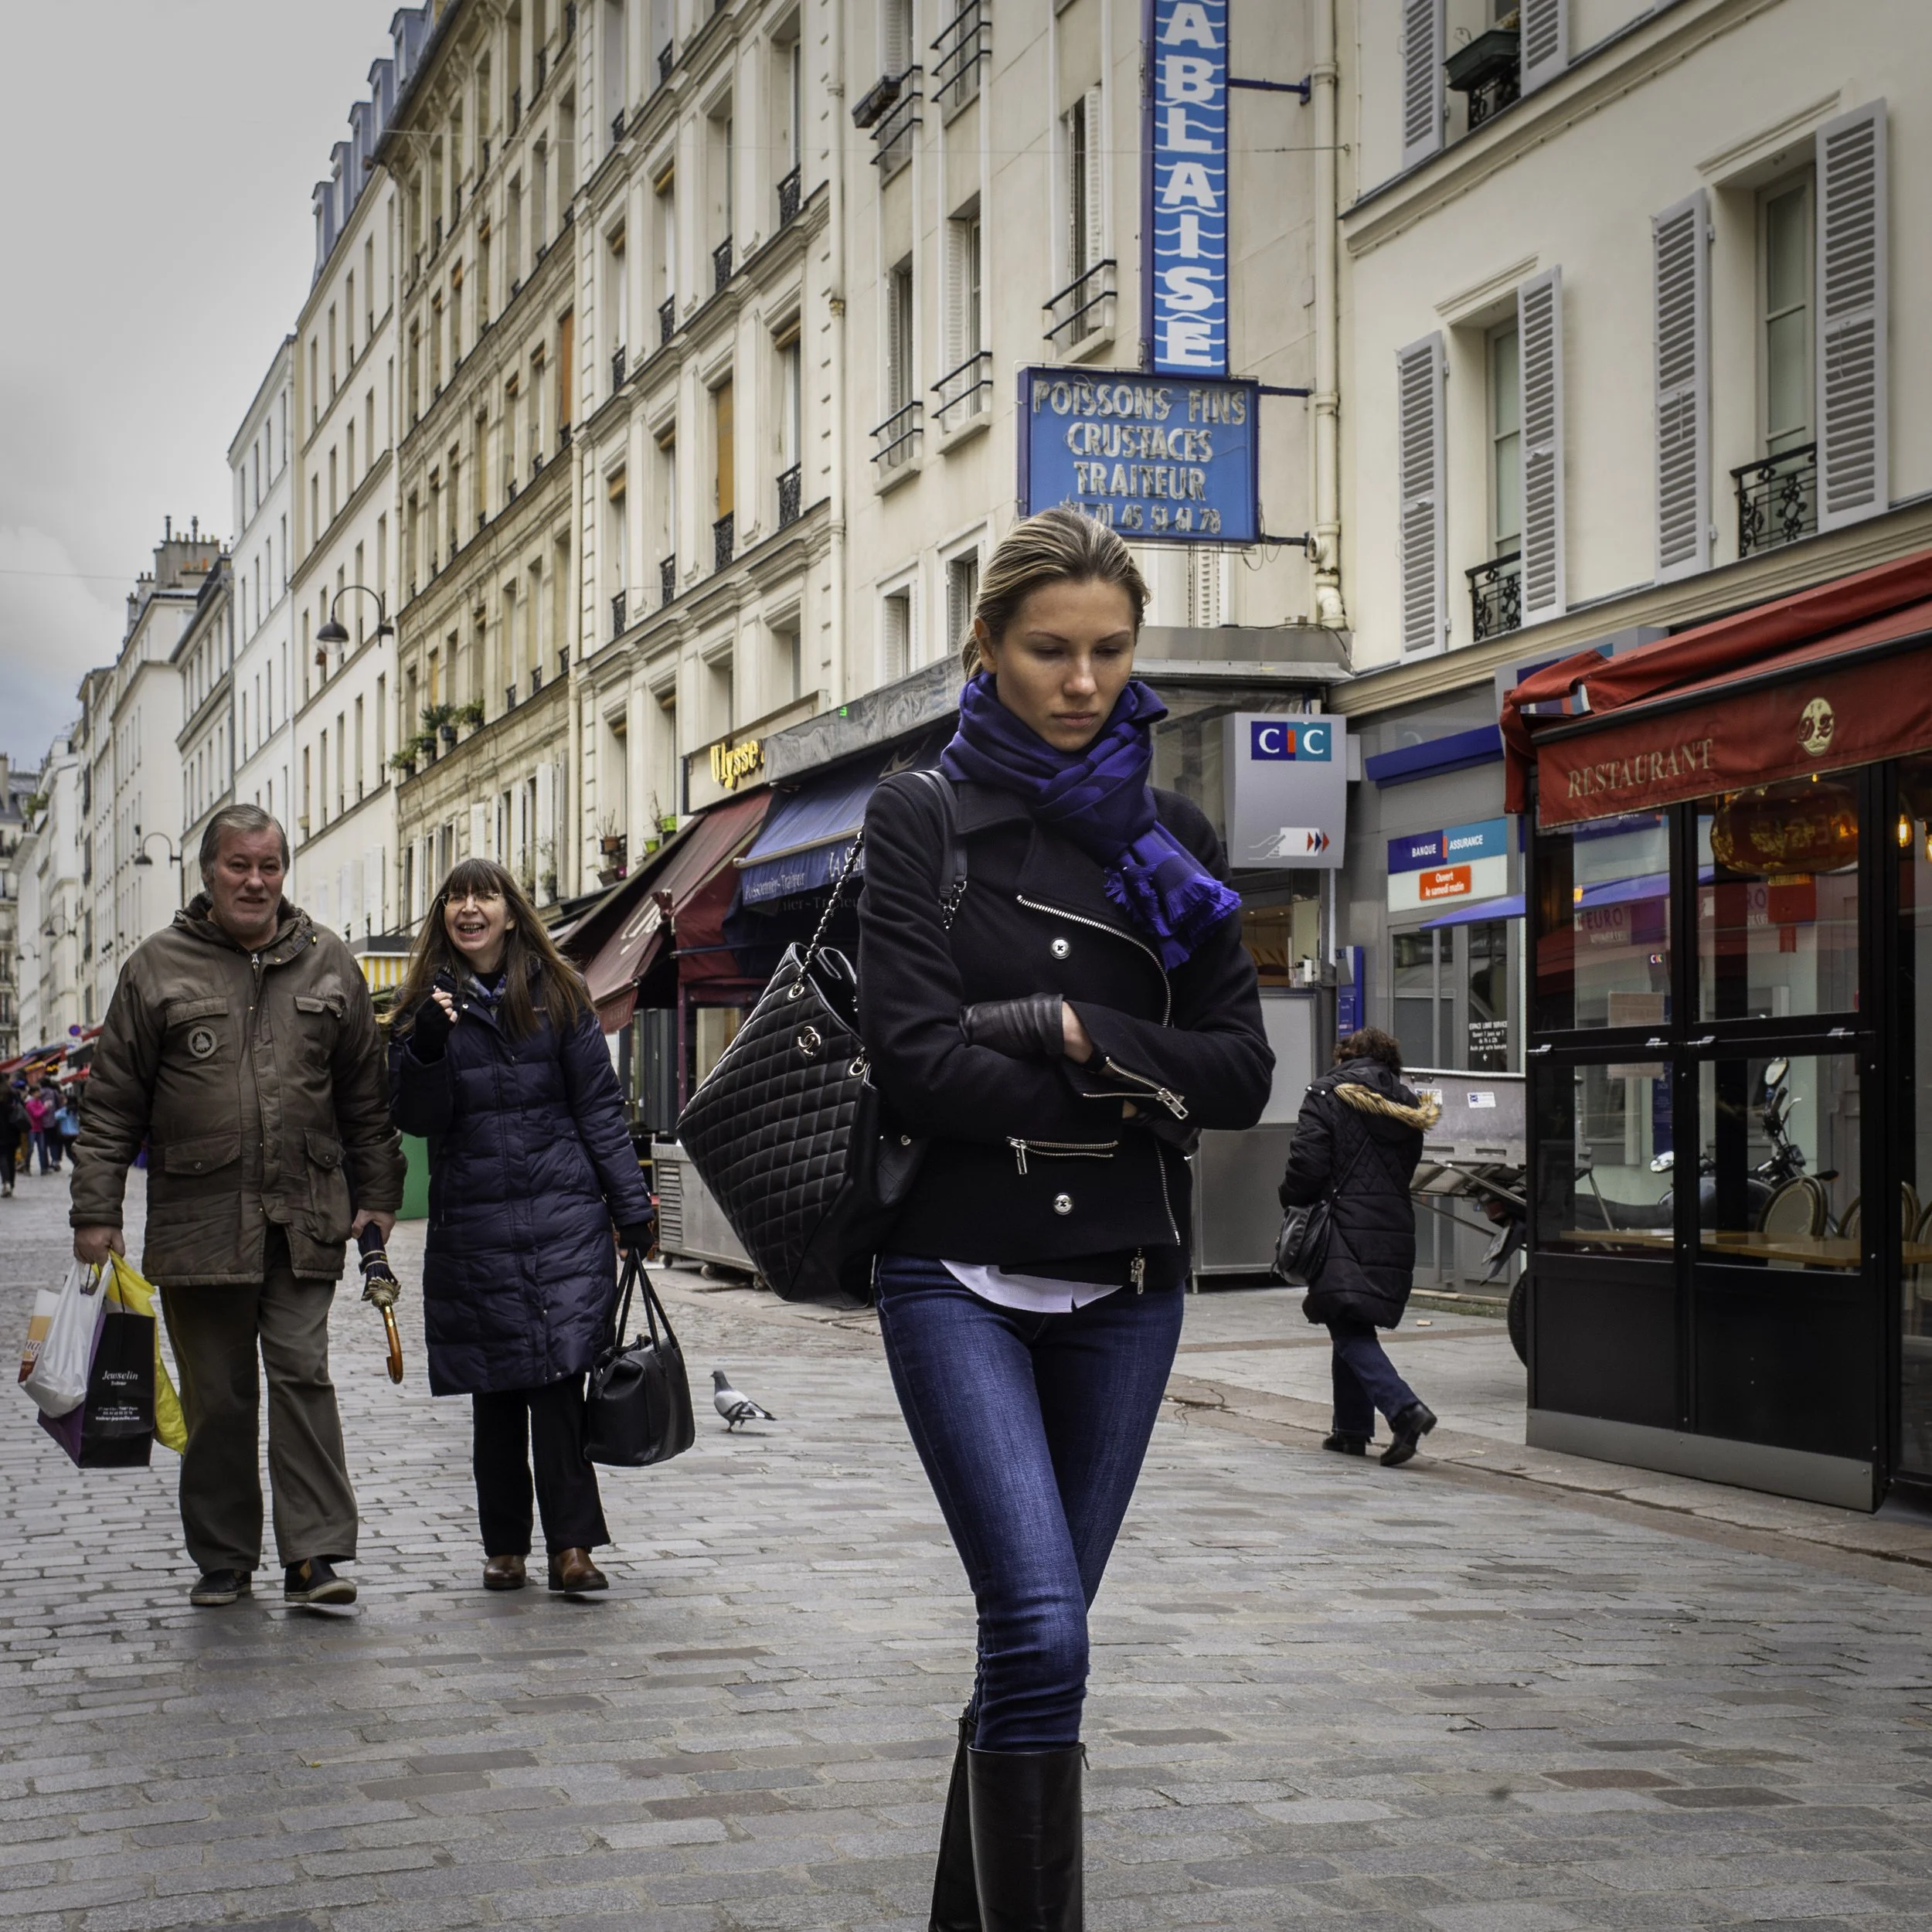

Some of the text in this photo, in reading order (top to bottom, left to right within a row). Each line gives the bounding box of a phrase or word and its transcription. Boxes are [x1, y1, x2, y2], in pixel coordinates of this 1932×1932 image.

[1163, 2, 1219, 367] ABLAISE
[1032, 380, 1247, 425] POISSONS FINS
[1067, 422, 1213, 462] CRUSTACES
[1073, 461, 1206, 501] TRAITEUR
[1121, 505, 1143, 529] 45
[1199, 509, 1221, 534] 78
[1259, 728, 1324, 754] CIC
[710, 740, 758, 788] Ulysse
[1568, 738, 1713, 798] RESTAURANT
[1412, 835, 1484, 858] BANQUE ASSURANCE
[1426, 882, 1464, 896] le samedi matin
[1436, 872, 1454, 883] Ouvert
